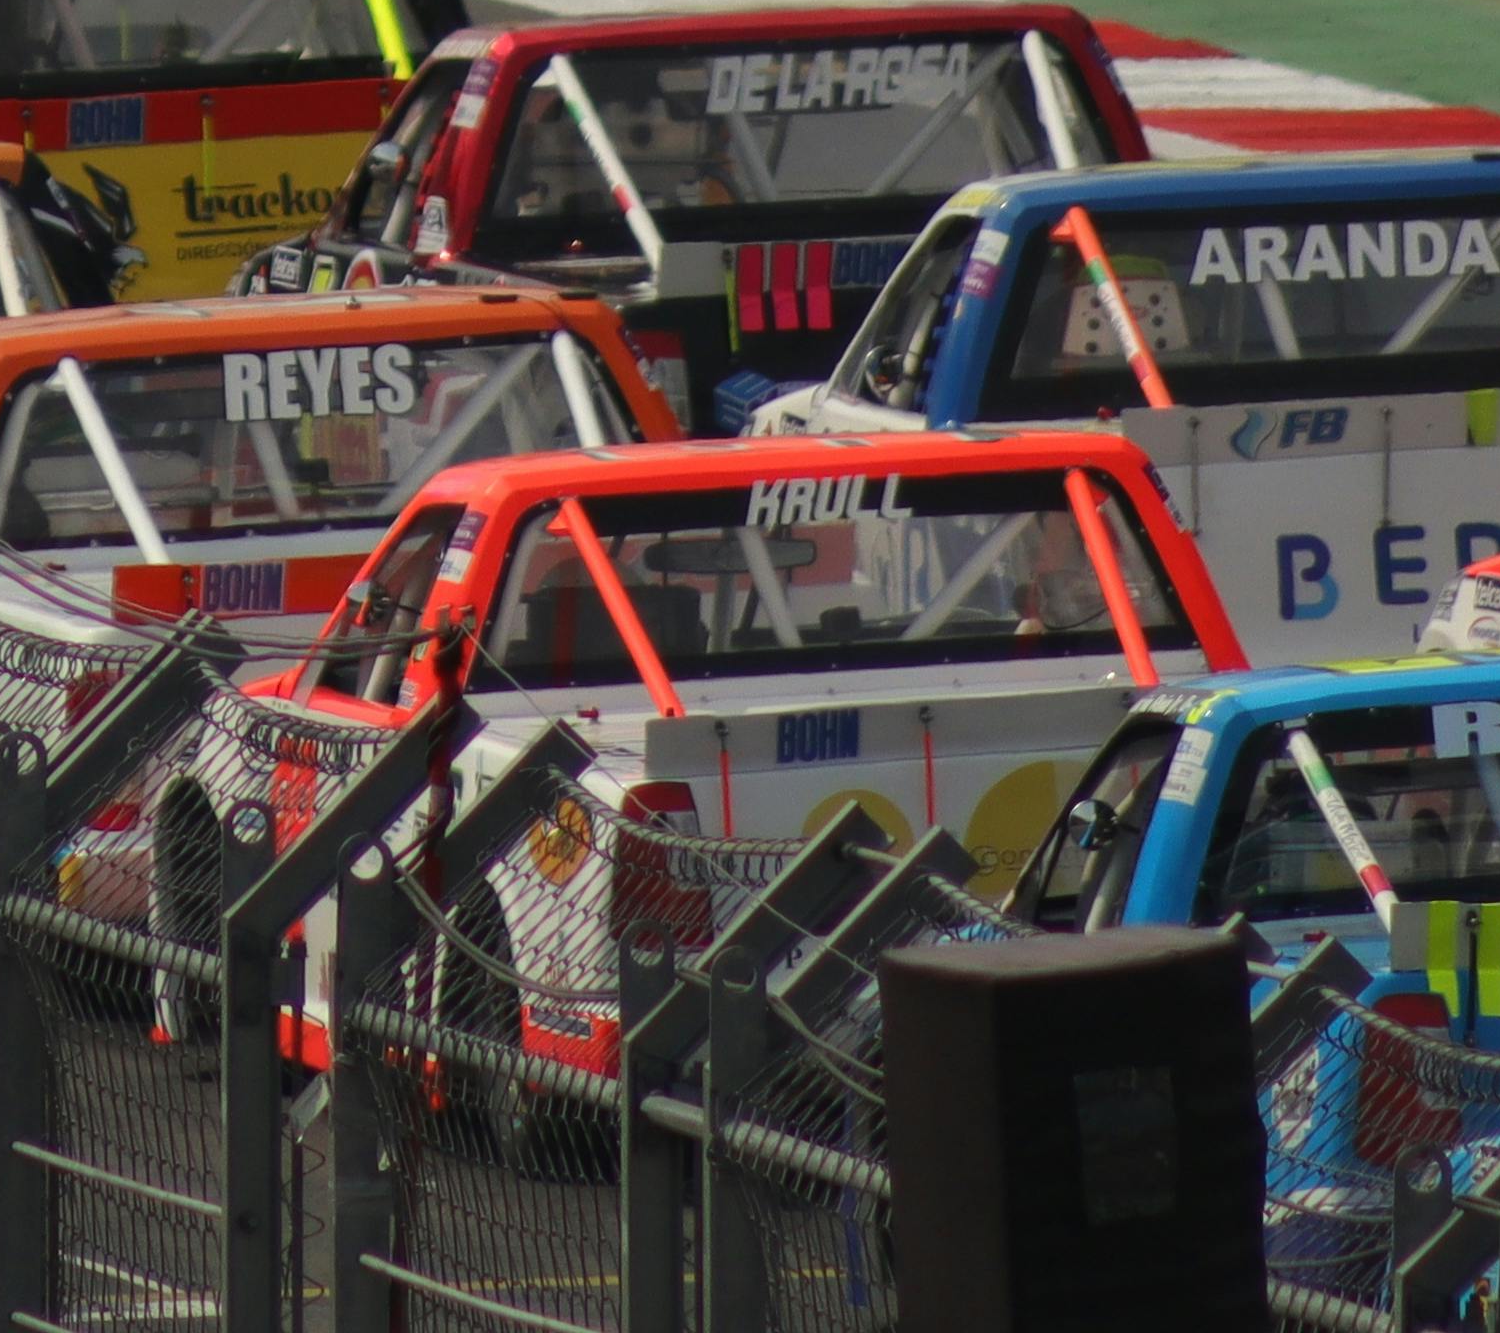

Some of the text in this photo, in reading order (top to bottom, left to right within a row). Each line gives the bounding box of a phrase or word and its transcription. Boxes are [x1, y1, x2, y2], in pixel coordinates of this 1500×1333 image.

[705, 53, 774, 115] DE
[774, 48, 838, 110] LA
[69, 97, 144, 146] BOHN
[222, 342, 416, 422] REYES
[1279, 406, 1348, 449] FB
[745, 473, 912, 533] KRULL
[206, 563, 283, 613] BOHN
[778, 709, 859, 763] BOHN
